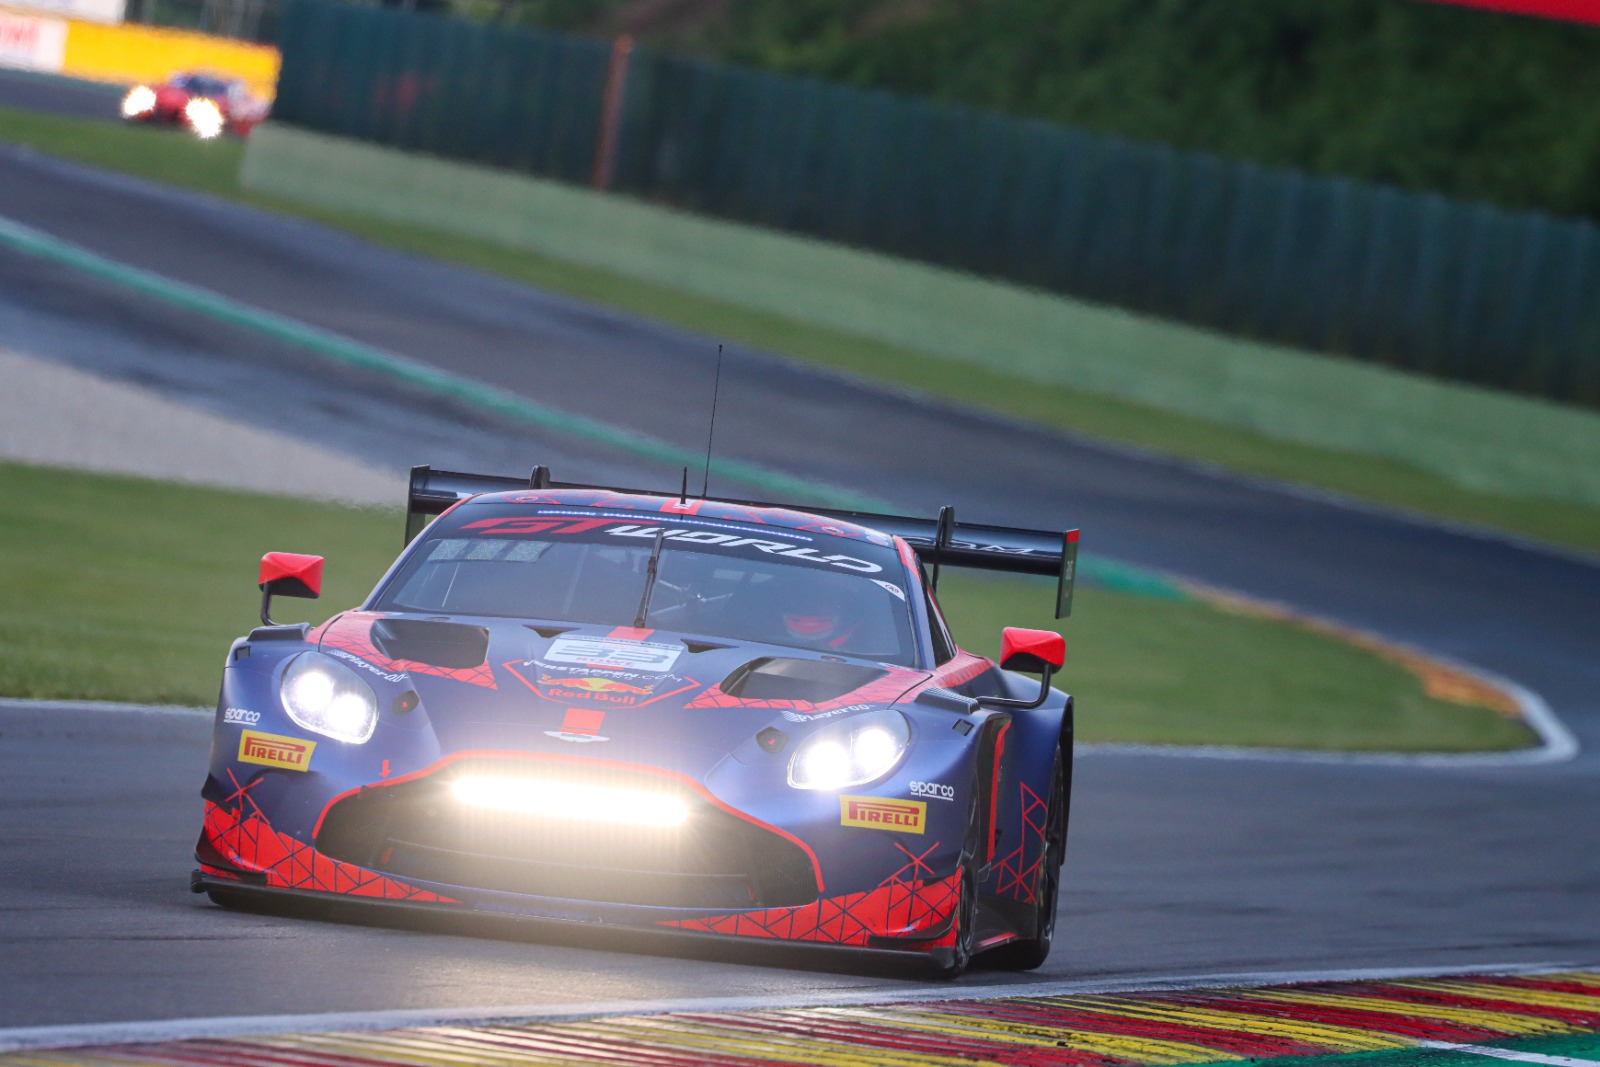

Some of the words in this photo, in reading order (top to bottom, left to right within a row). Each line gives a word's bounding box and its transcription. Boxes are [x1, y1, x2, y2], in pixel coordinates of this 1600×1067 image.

[459, 516, 662, 535] GT
[603, 525, 882, 573] WORLD
[548, 688, 592, 700] Red
[594, 692, 636, 705] Bull
[224, 707, 261, 724] sparco
[244, 736, 306, 765] PIRELLI
[909, 781, 954, 799] sparco
[847, 800, 920, 827] PIRELLI
